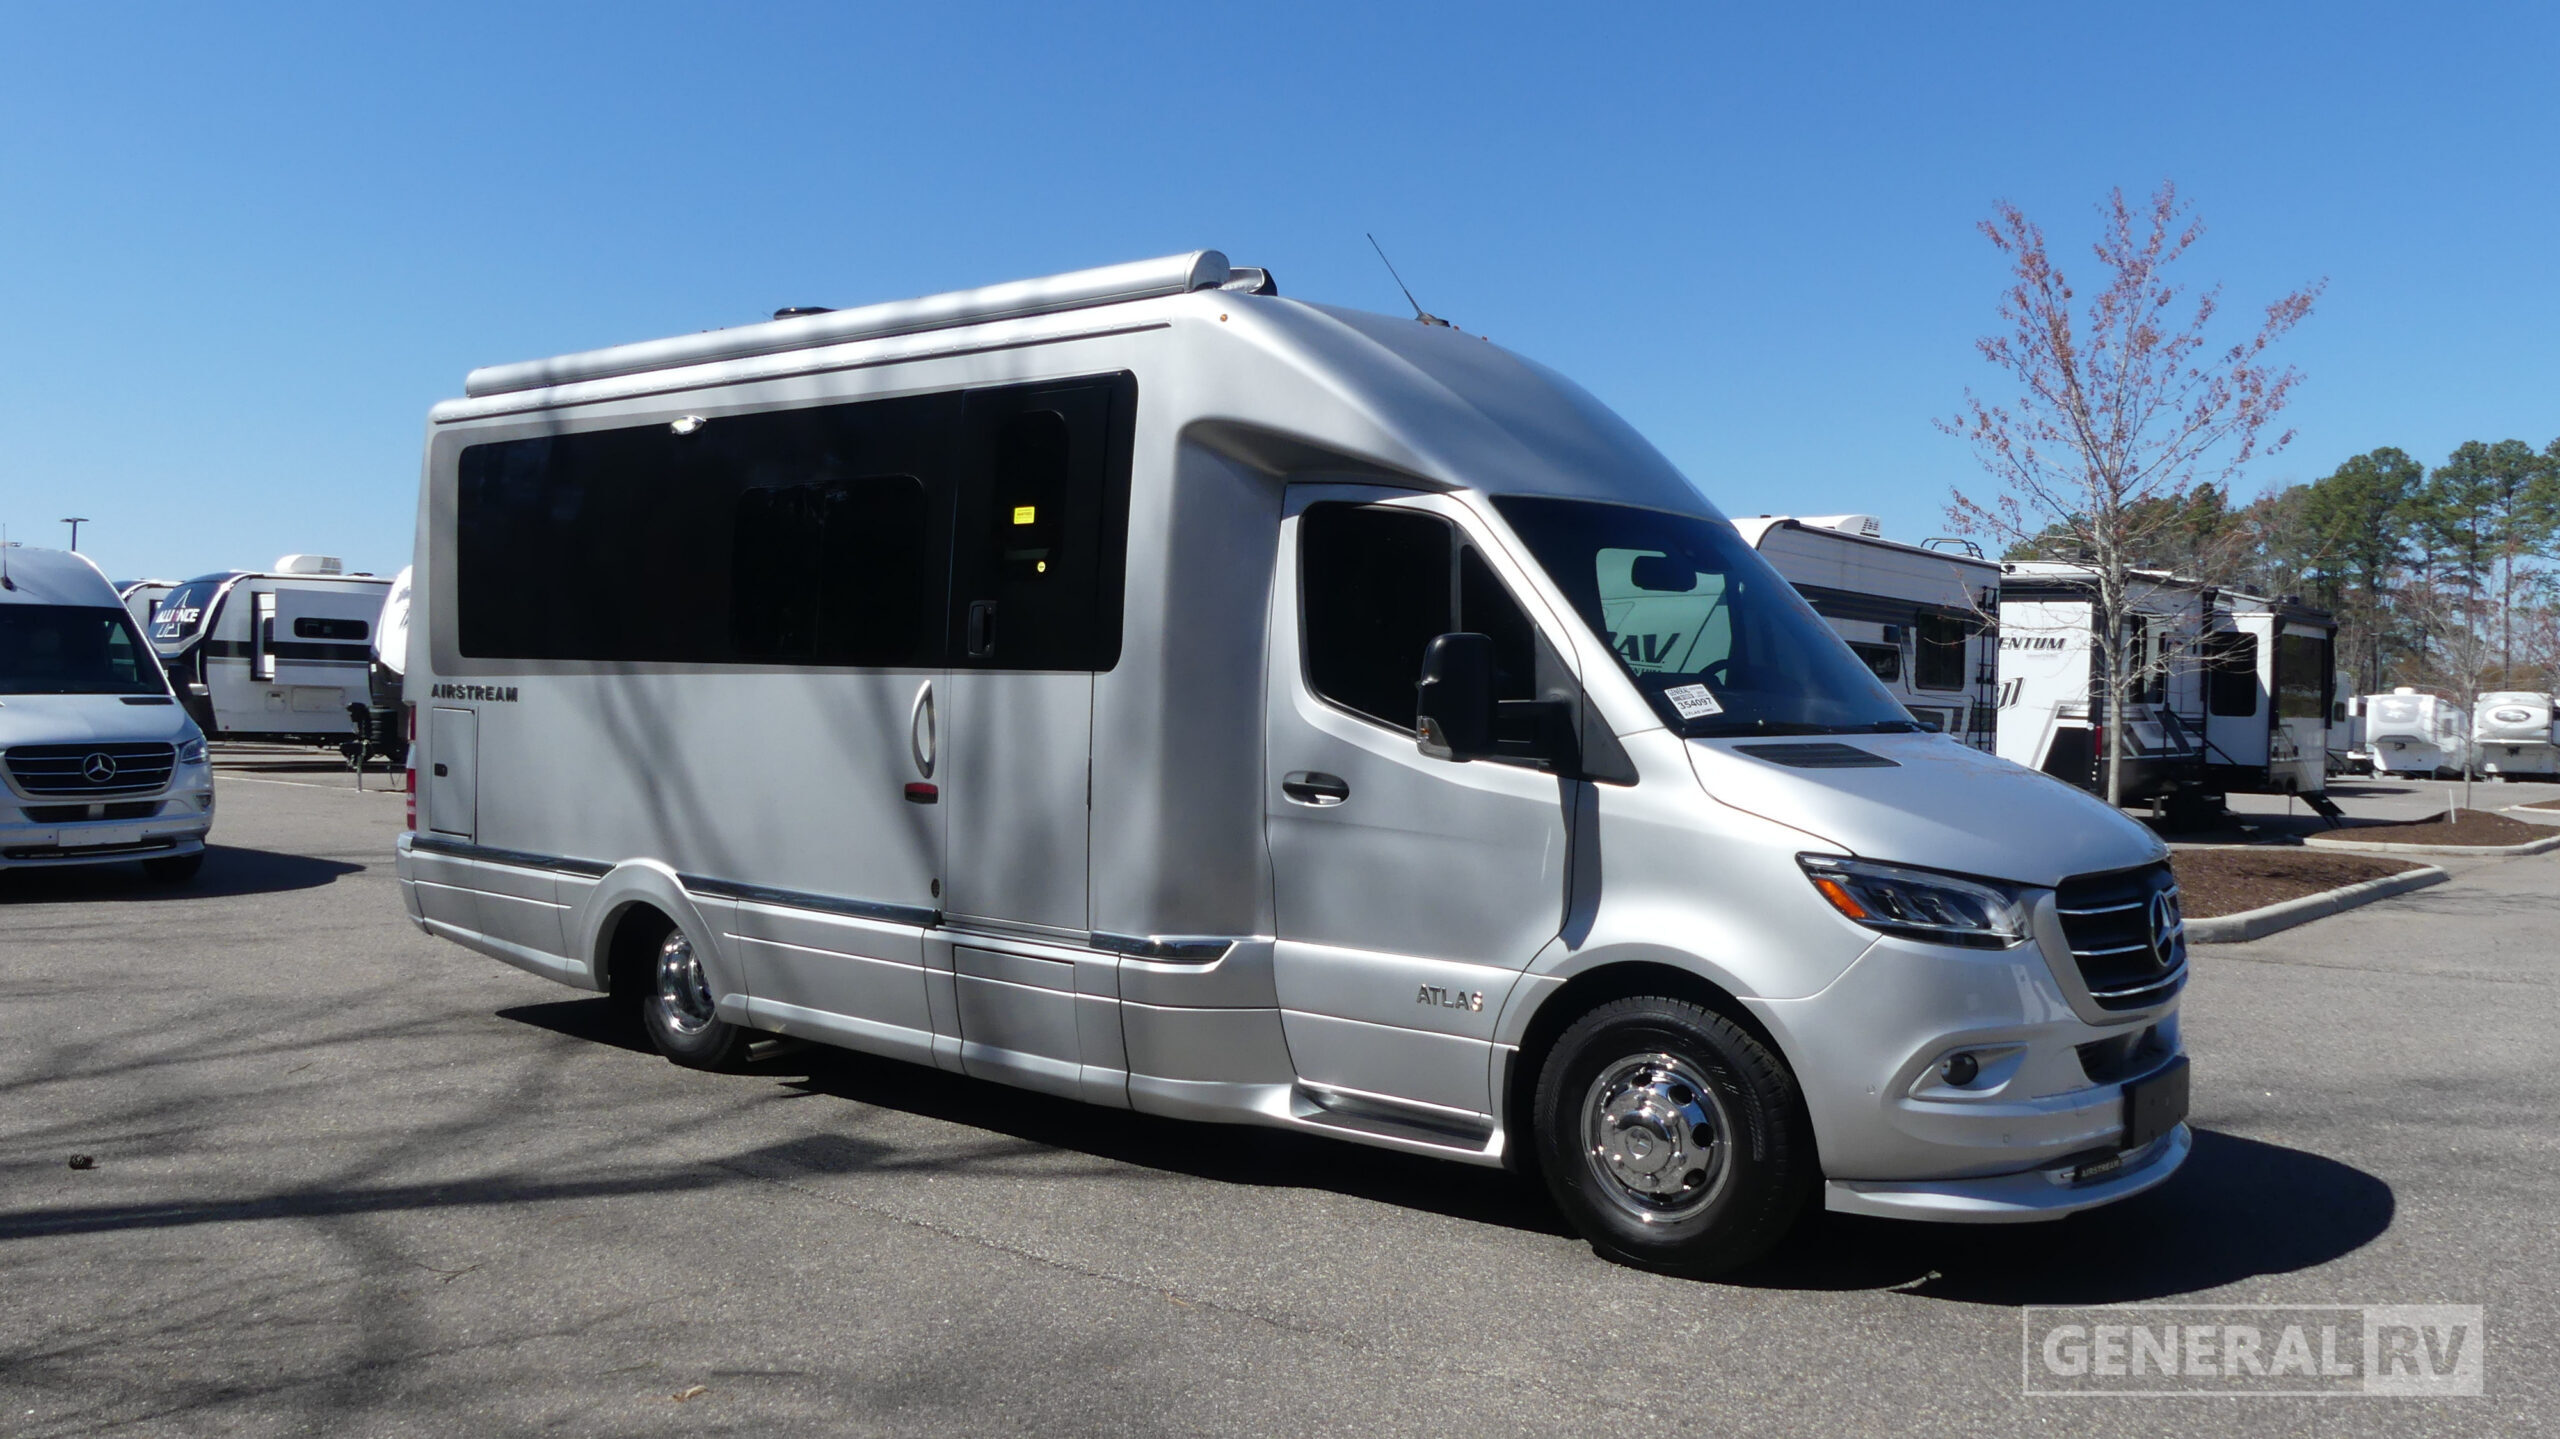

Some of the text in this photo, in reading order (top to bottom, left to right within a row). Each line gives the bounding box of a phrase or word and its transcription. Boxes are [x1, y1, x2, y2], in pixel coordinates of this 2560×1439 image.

[431, 683, 519, 702] AIRSTREAM
[1677, 697, 1713, 710] 354097
[1416, 983, 1484, 1013] ATLAS
[2081, 1159, 2120, 1177] AIRSTREAM
